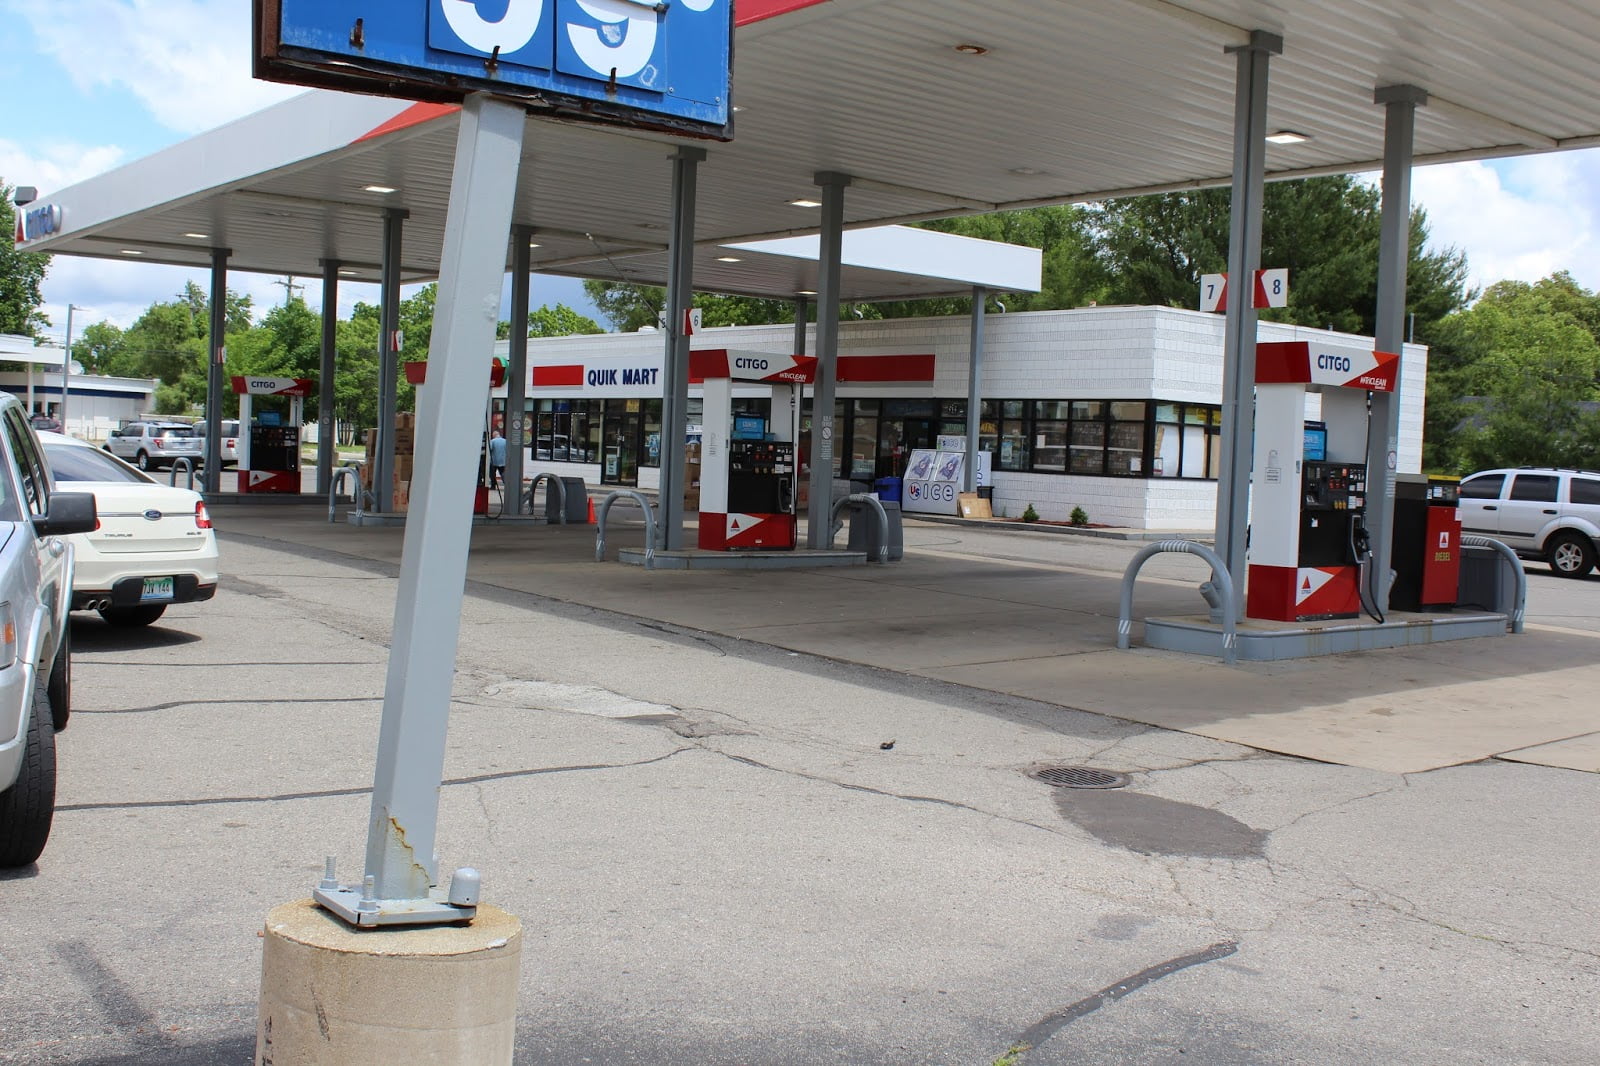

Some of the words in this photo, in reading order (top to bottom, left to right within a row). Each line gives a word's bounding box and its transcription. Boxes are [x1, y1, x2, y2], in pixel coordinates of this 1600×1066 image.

[1207, 284, 1214, 299] 7
[1273, 279, 1281, 295] 8
[693, 315, 699, 327] 6
[735, 357, 769, 370] CITGO
[1317, 354, 1351, 373] CITGO
[250, 380, 276, 389] CITGO
[587, 369, 618, 387] QUIK
[622, 368, 659, 385] MART
